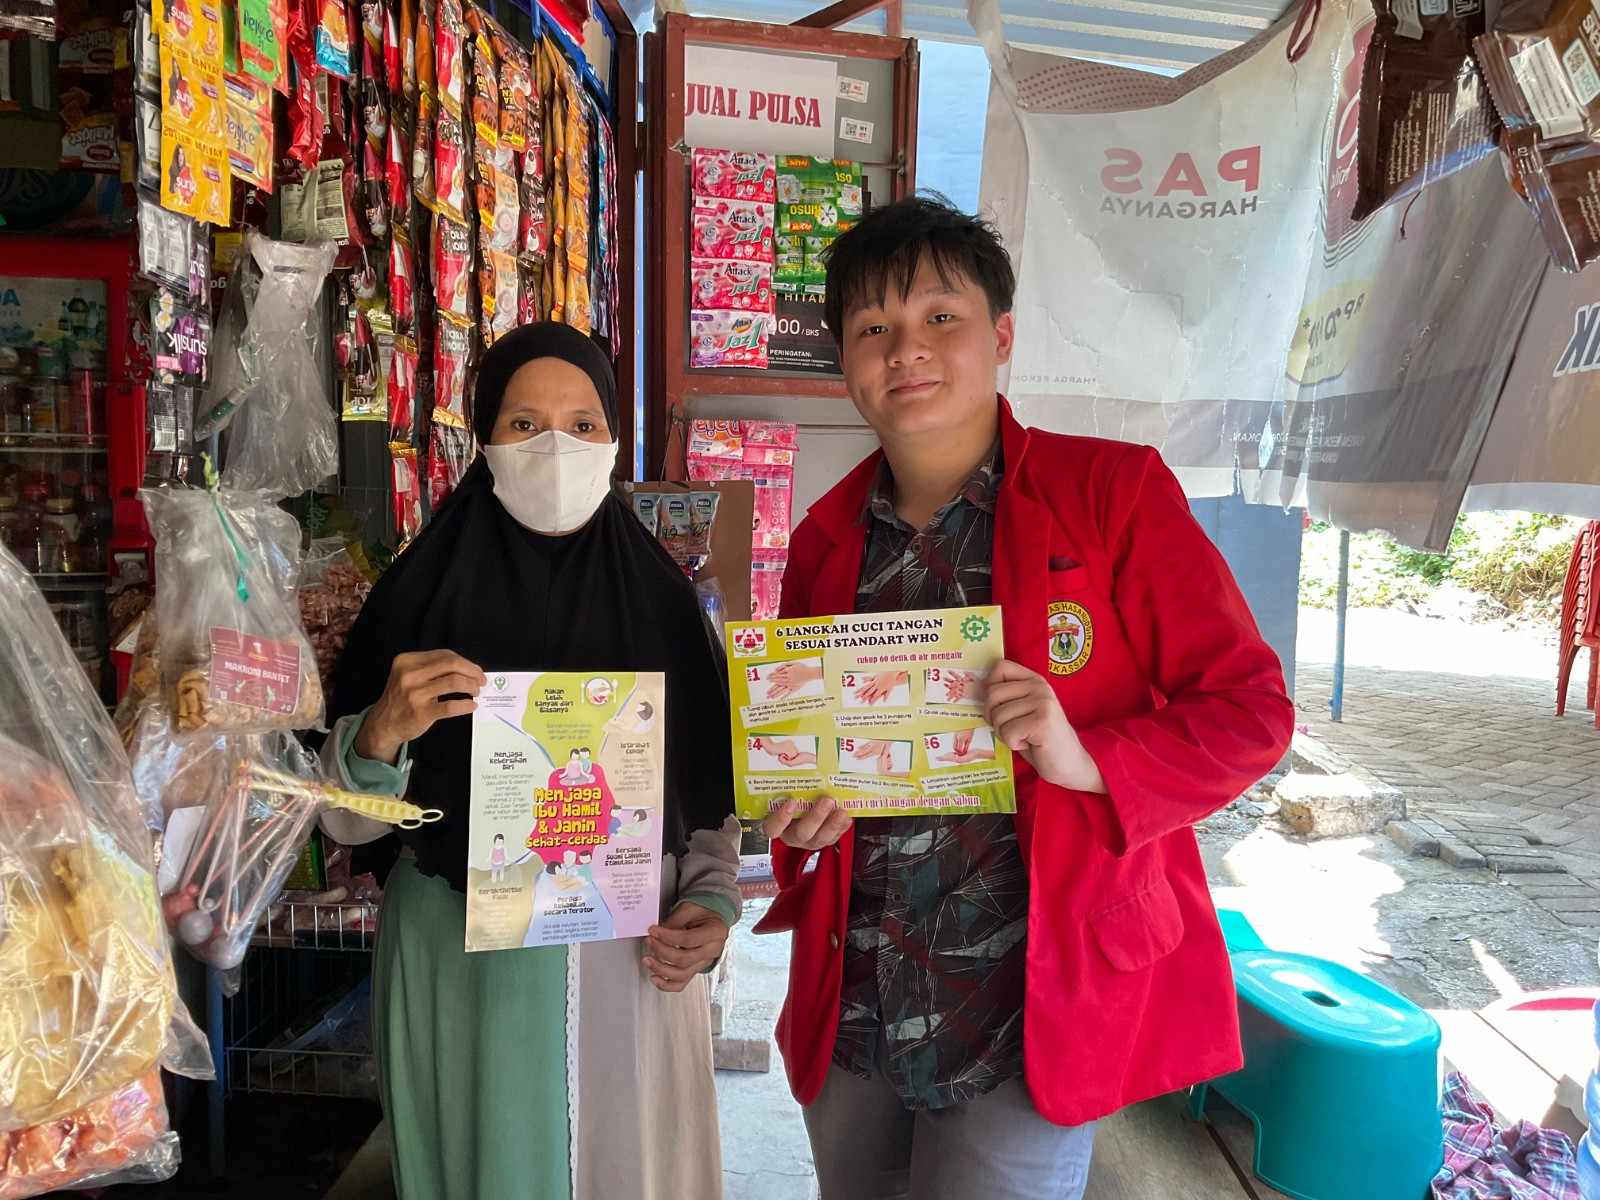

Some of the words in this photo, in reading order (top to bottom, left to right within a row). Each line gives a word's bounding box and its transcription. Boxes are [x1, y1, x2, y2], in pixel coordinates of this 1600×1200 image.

[685, 83, 741, 119] JUAL
[748, 89, 822, 129] PULSA
[728, 211, 757, 224] Attack
[724, 263, 753, 276] Attack
[166, 331, 207, 356] sunsilk
[776, 628, 783, 637] 6
[786, 624, 849, 637] LANGKAH
[852, 622, 883, 633] CUCI
[886, 618, 944, 631] TANGAN
[785, 638, 832, 650] SESUAI
[834, 636, 905, 648] STANDART
[908, 633, 939, 643] WHO
[856, 655, 878, 665] cukup
[847, 674, 855, 687] 2
[931, 668, 940, 682] 3
[753, 738, 763, 750] 4
[845, 739, 854, 752] 5
[930, 736, 940, 749] 6
[534, 787, 602, 802] Menjaga
[534, 803, 558, 818] Ibu
[538, 820, 549, 834] &
[553, 819, 597, 834] Janin
[526, 834, 608, 848] sehat-cerdas
